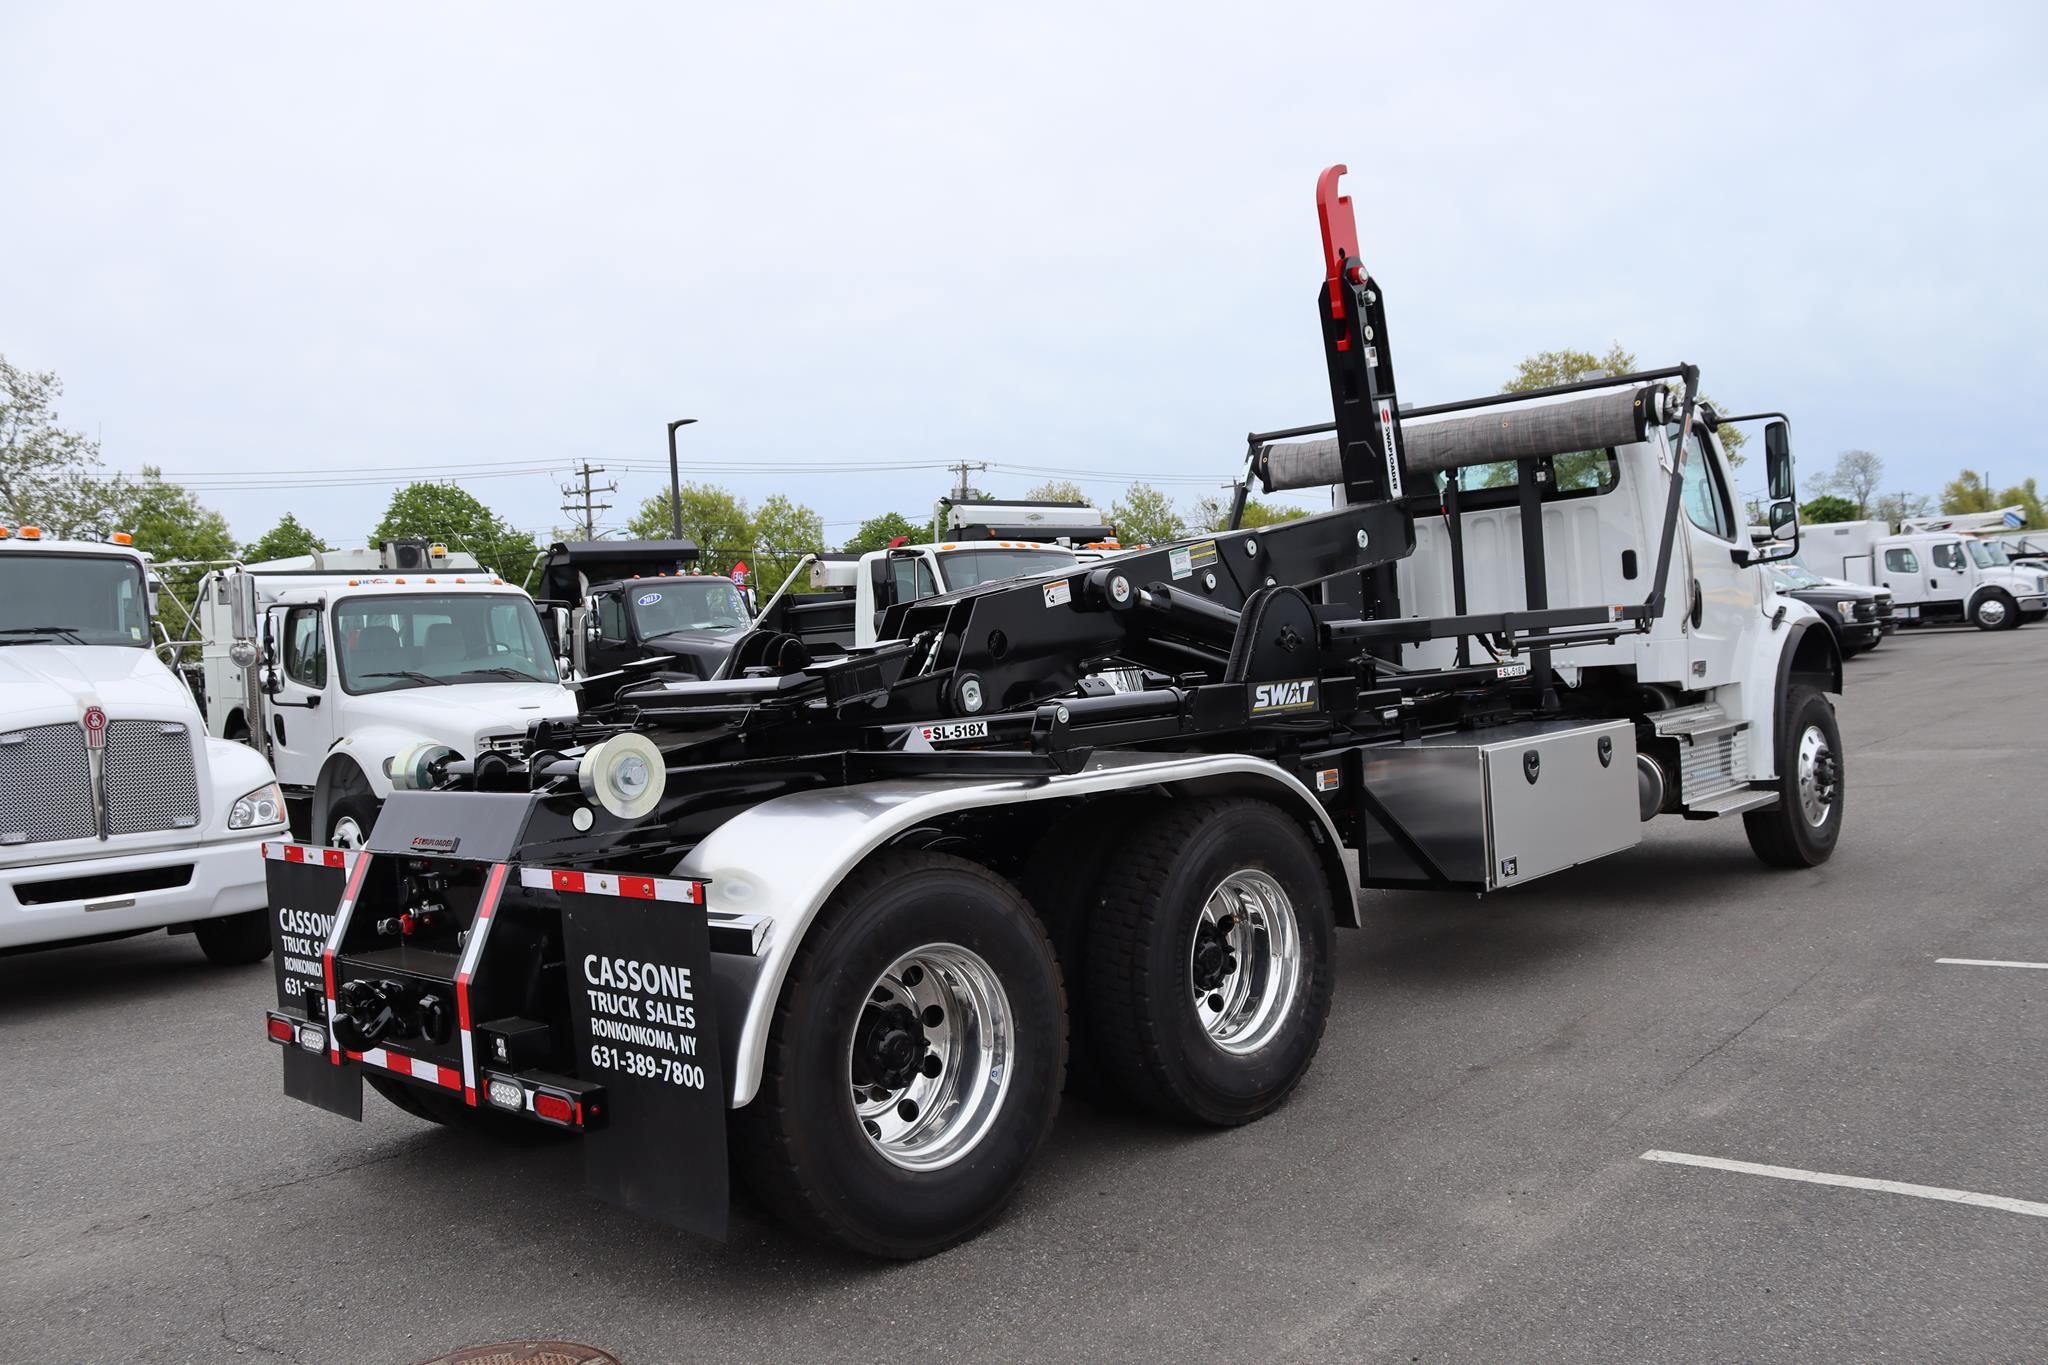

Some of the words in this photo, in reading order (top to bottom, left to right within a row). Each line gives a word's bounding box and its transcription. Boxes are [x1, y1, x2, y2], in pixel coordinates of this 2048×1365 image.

[1385, 427, 1398, 489] SWAPLOADER
[1254, 680, 1314, 708] SWAT
[933, 723, 985, 740] SL-518X
[282, 935, 312, 957] TRUCK
[584, 954, 694, 1001] CASSONE
[587, 989, 641, 1020] TRUCK
[645, 1000, 696, 1030] SALES
[590, 1017, 679, 1055] RONKONKOMA,
[680, 1034, 697, 1056] NY
[590, 1044, 705, 1090] 631-389-7800
